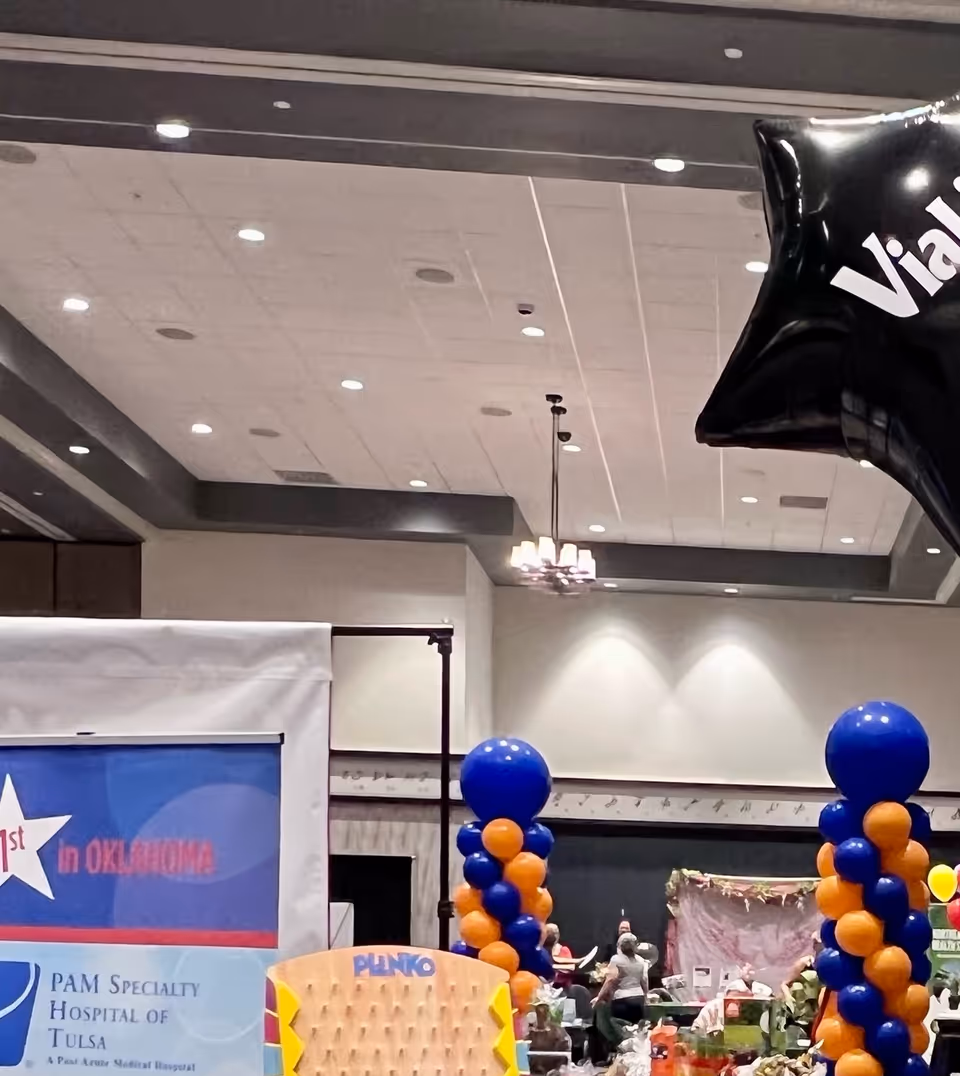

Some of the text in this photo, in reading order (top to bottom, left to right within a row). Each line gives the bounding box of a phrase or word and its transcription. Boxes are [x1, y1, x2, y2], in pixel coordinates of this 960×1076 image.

[0, 825, 216, 875] 1st in OKLAHOMA
[51, 972, 99, 994] PAM
[50, 1000, 138, 1023] HOSPITAL
[48, 1028, 107, 1050] TULSA
